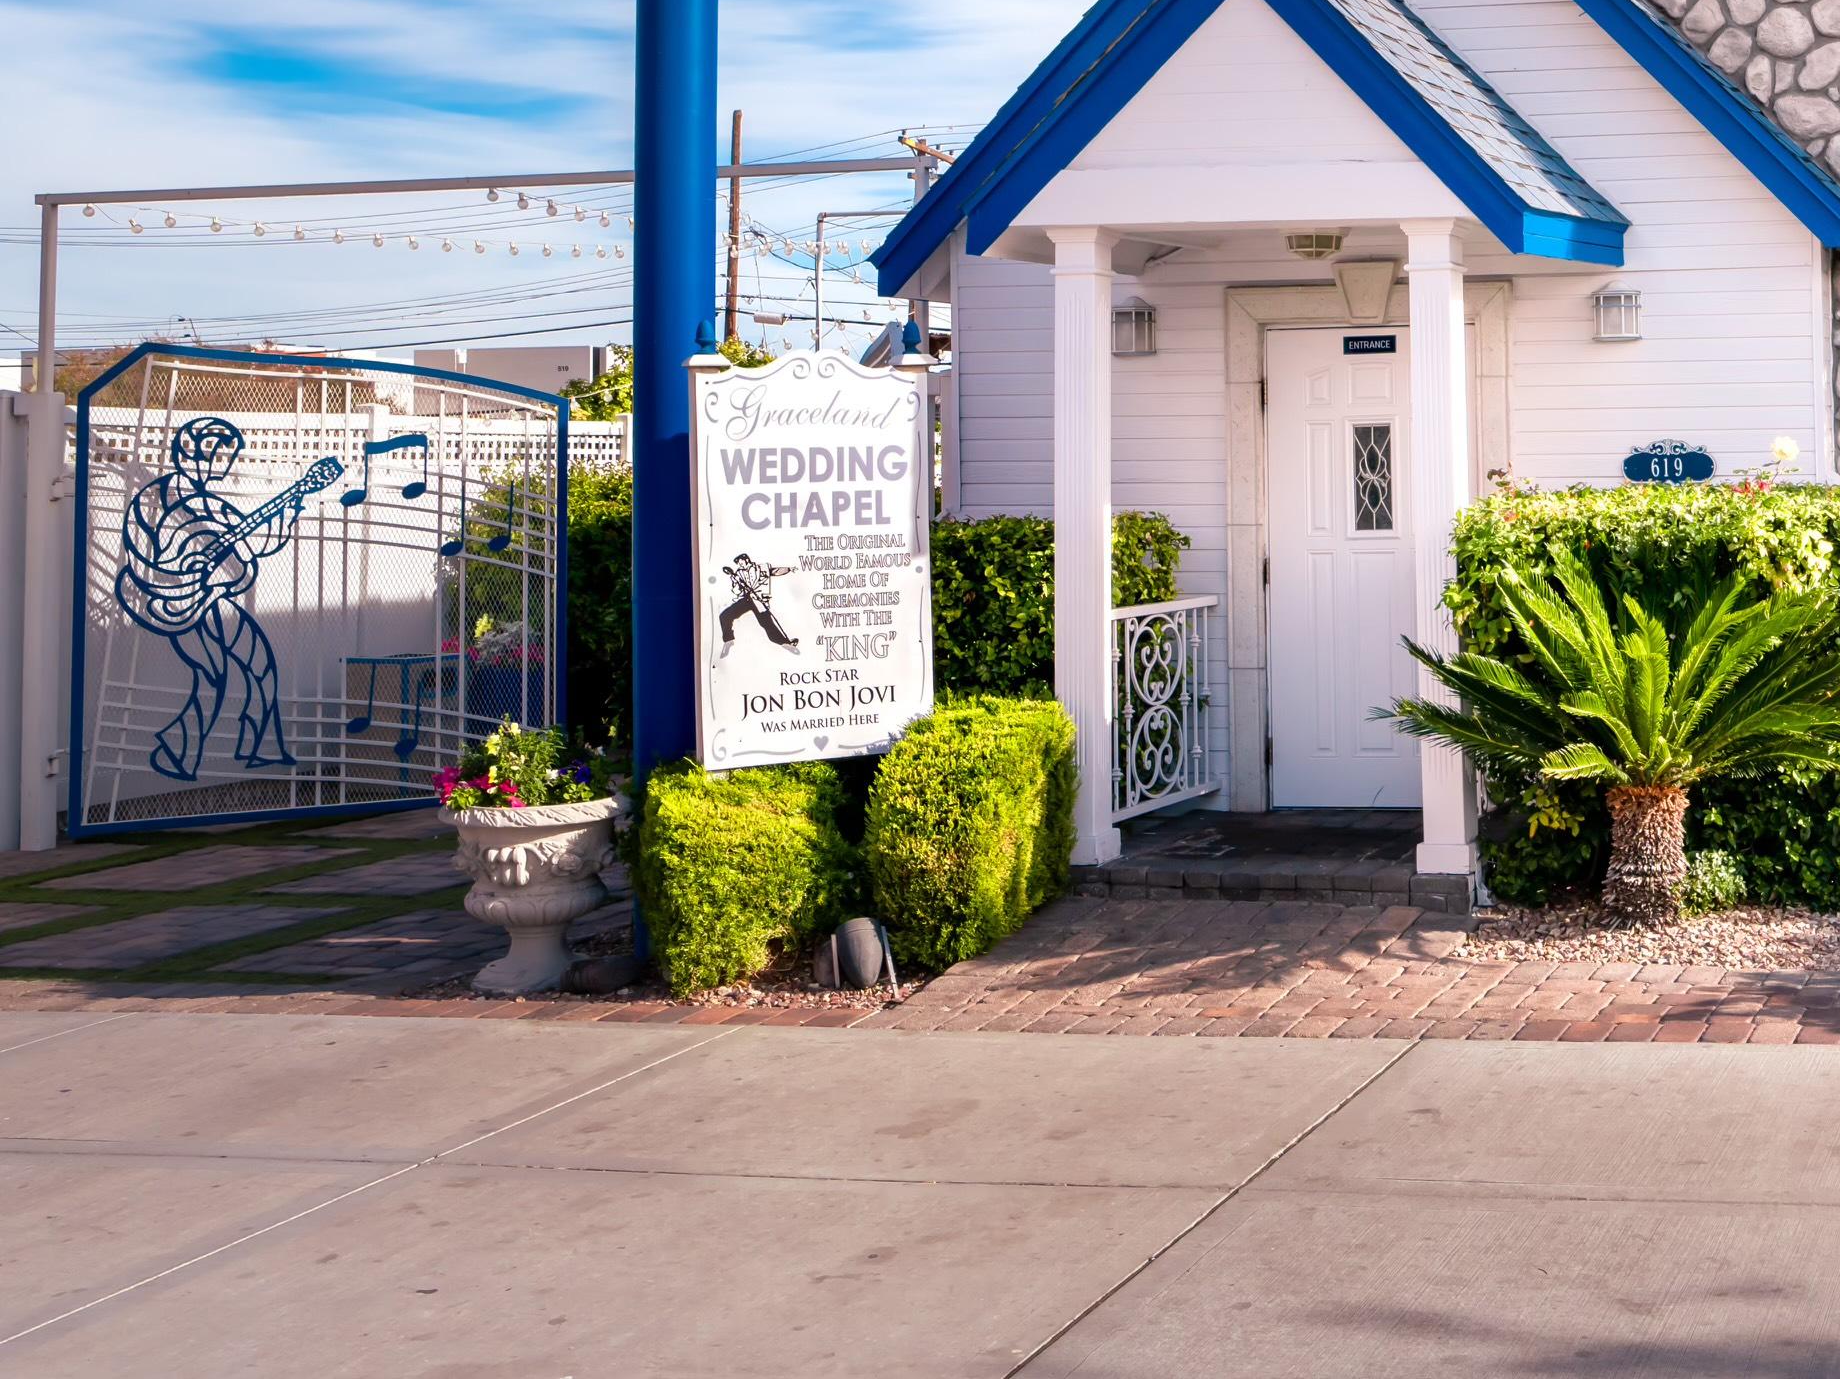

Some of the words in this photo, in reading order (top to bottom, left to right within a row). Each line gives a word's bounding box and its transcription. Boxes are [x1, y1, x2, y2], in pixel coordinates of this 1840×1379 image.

[1348, 340, 1391, 350] ENTRANCE
[725, 385, 901, 442] Graceland
[720, 445, 908, 485] WEDDING
[1651, 458, 1683, 477] 619
[741, 490, 891, 530] CHAPEL
[804, 535, 834, 551] THE
[837, 534, 906, 550] ORIGINAL
[799, 555, 852, 571] WORLD
[855, 552, 911, 569] FAMOUS
[822, 573, 866, 590] HOME
[869, 571, 889, 587] OF
[812, 591, 900, 609] CEREMONIES
[820, 611, 860, 628] WITH
[863, 609, 892, 625] THE
[780, 671, 821, 686] ROCK
[825, 668, 859, 682] STAR
[741, 693, 784, 721] JON
[793, 689, 840, 710] BON
[849, 685, 896, 712] JOVI
[760, 721, 787, 733] WAS
[790, 716, 845, 731] MARRIED
[848, 713, 880, 726] HERE
